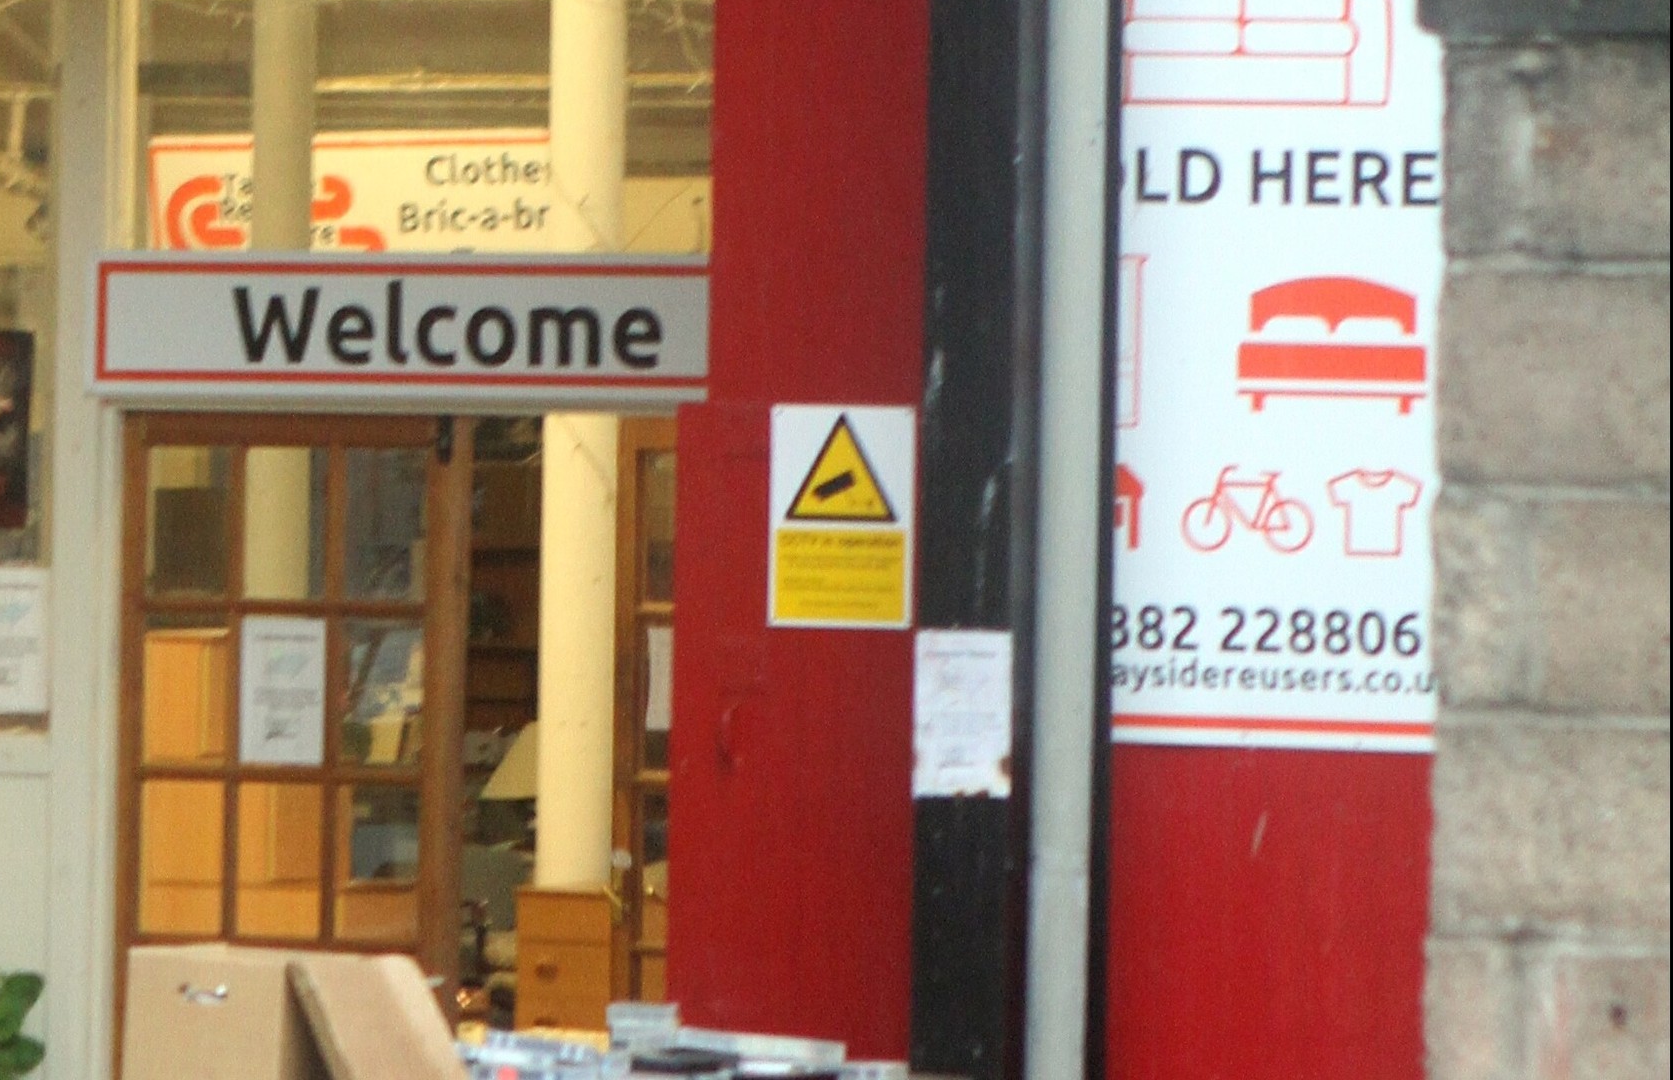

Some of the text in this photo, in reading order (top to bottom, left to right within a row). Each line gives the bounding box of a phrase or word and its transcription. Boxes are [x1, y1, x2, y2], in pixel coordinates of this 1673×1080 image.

[1119, 147, 1439, 207] LD HERE
[232, 277, 664, 369] Welcome
[1218, 606, 1423, 658] 228806
